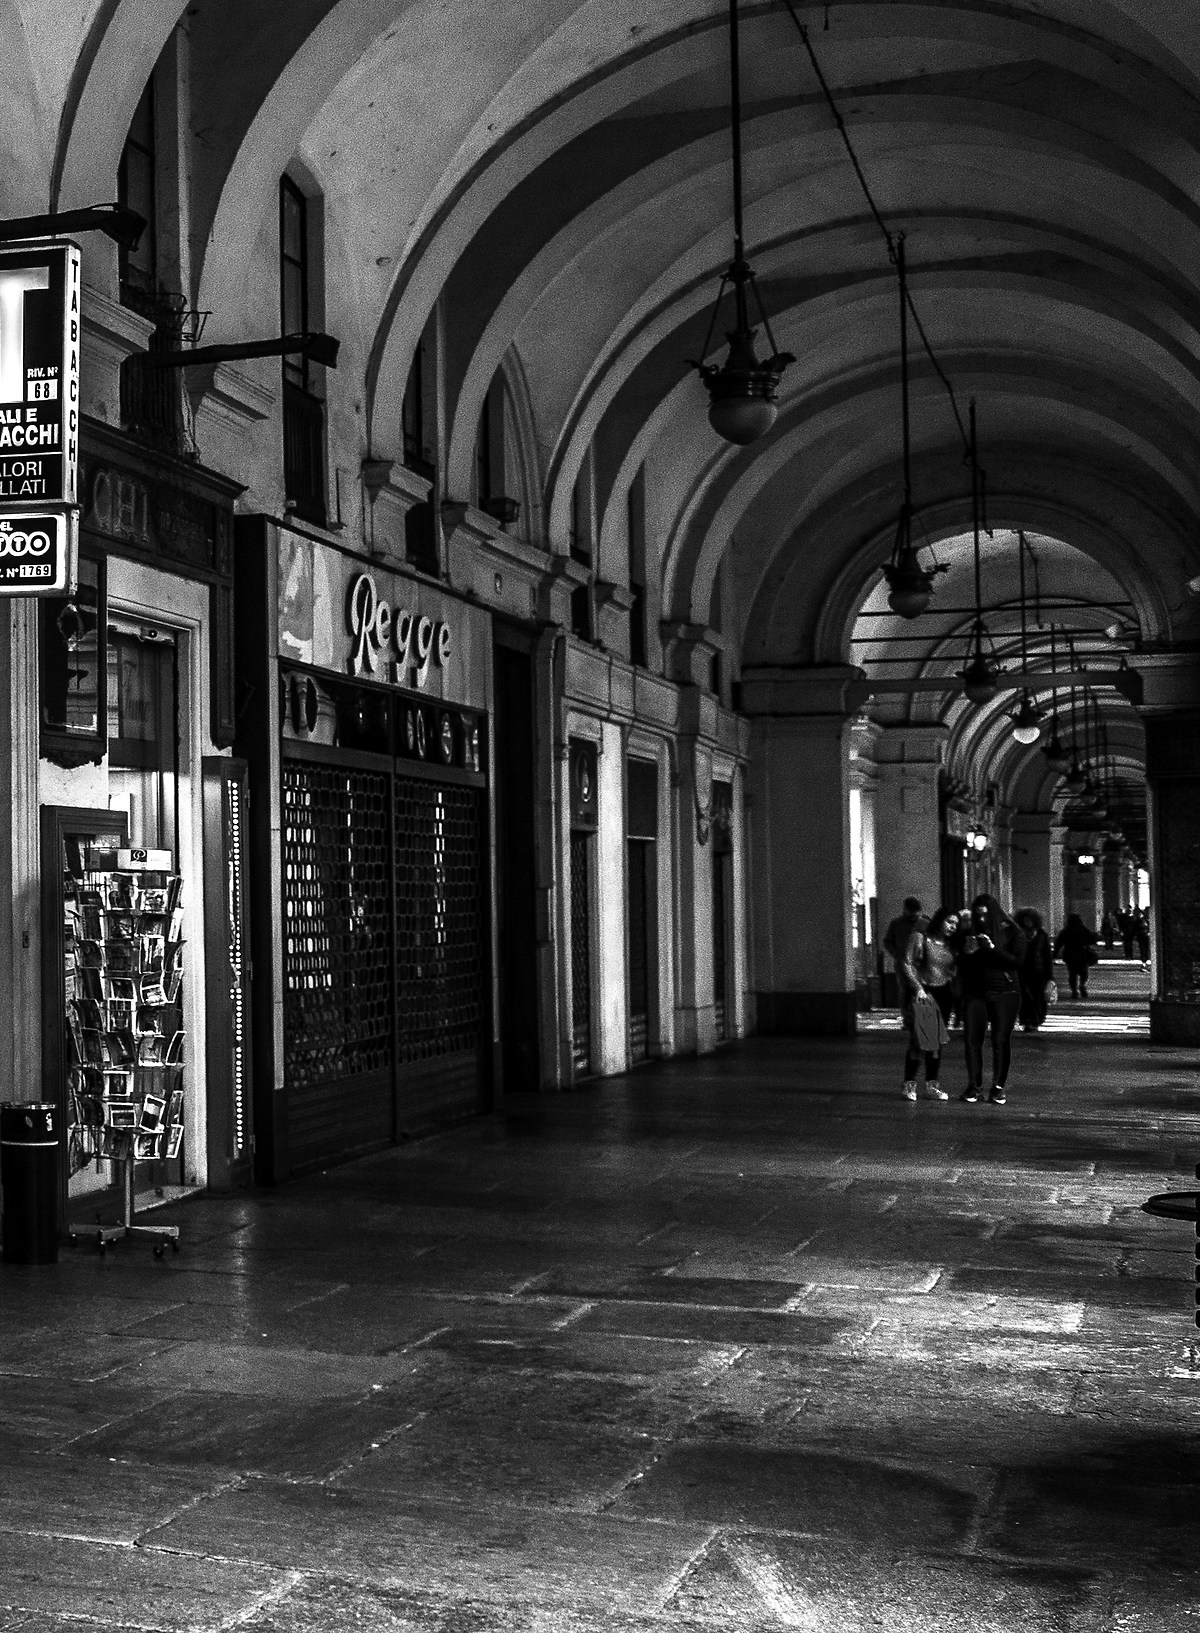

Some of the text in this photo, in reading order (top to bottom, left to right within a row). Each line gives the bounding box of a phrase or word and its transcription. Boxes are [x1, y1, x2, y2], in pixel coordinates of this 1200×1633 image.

[27, 367, 45, 378] RIV.
[68, 259, 79, 492] TABACCHI
[34, 382, 50, 399] 68
[25, 407, 38, 423] E
[20, 564, 51, 577] 1769
[348, 572, 453, 689] Regge
